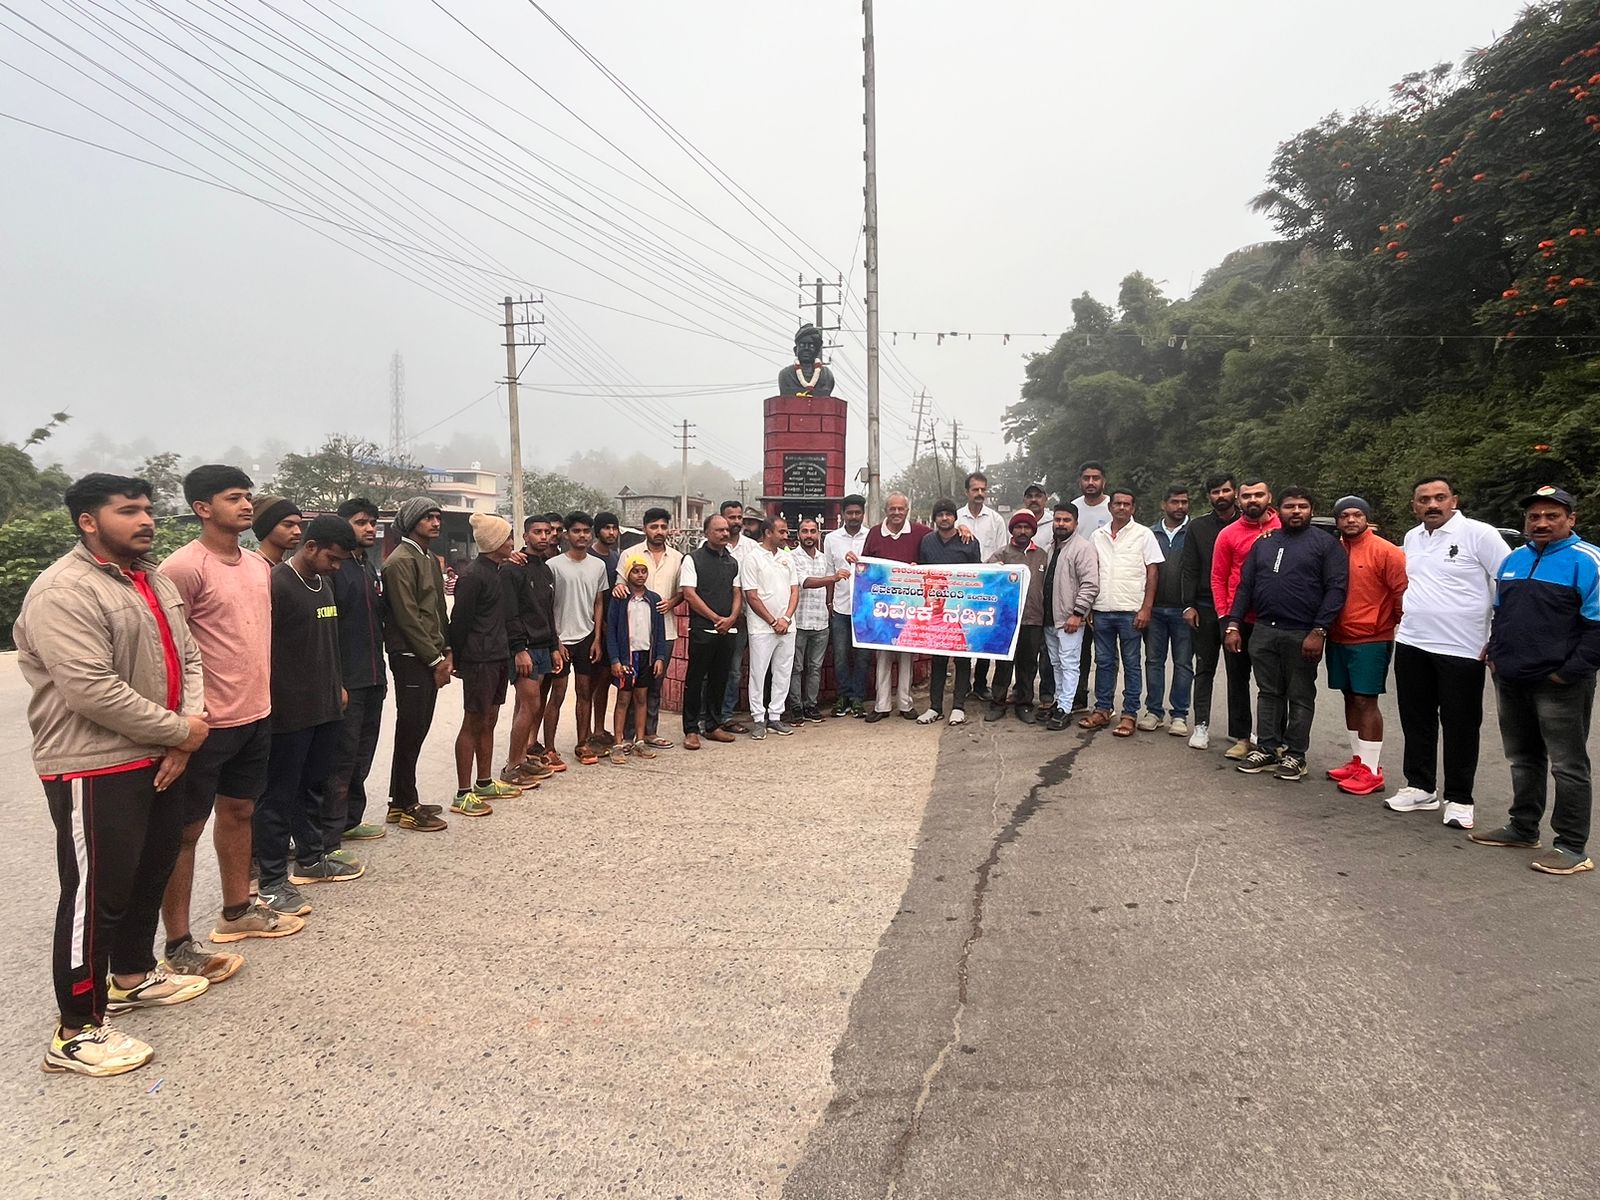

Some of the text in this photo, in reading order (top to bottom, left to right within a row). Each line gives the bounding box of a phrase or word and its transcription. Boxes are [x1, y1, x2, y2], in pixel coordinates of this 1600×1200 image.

[871, 584, 925, 598] ವಿವೇಕಾನಂದ
[928, 586, 964, 600] ಜಯಂತಿ
[873, 600, 996, 626] ವಿವೇಕ ನಡಿಗೆ
